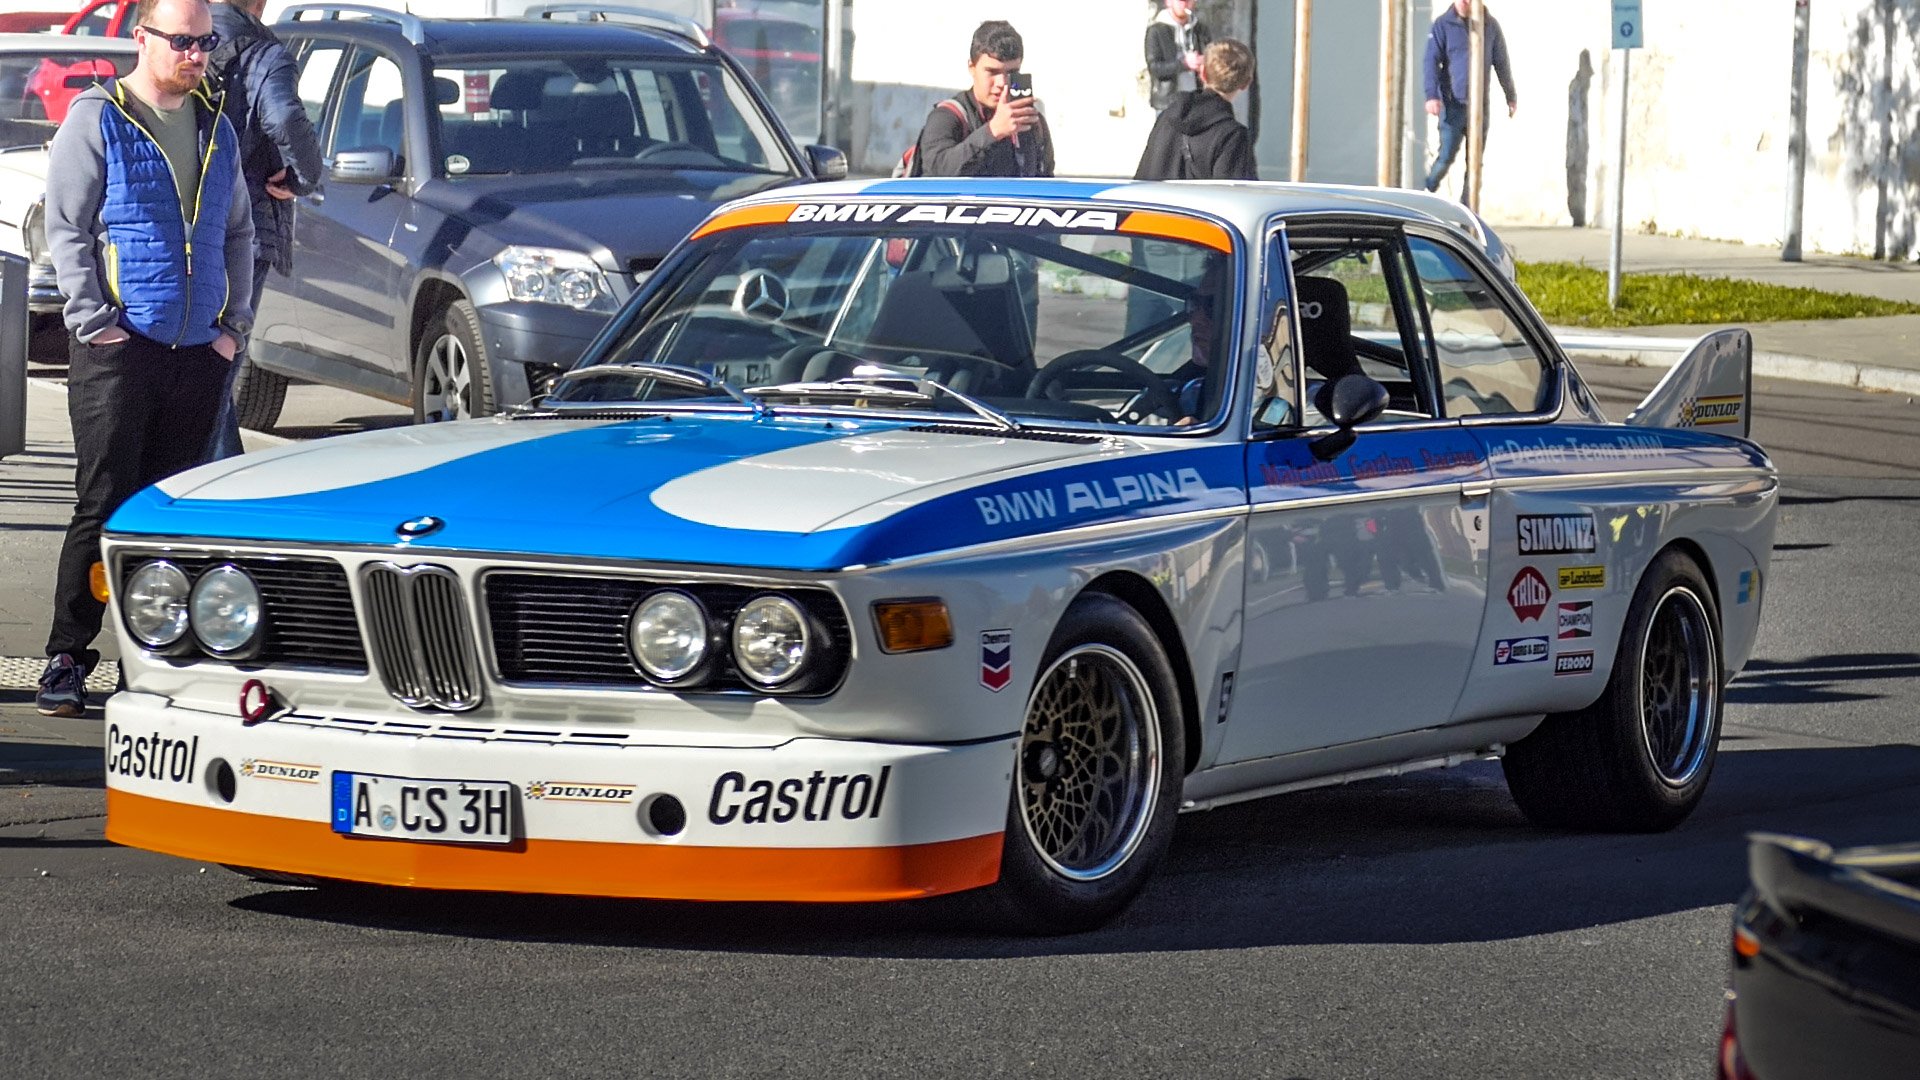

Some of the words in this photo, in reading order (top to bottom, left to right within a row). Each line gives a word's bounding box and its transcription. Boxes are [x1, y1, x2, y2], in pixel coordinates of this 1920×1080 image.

[787, 204, 893, 222] BMW
[896, 204, 1118, 230] ALPINA
[715, 364, 729, 385] M
[1696, 403, 1741, 418] DUNLOP
[1506, 438, 1564, 464] Dealer
[1566, 437, 1615, 463] Team
[1616, 436, 1666, 460] BMW
[975, 488, 1057, 525] BMW
[1065, 467, 1210, 514] ALPINA
[1518, 517, 1594, 551] SIMONIZ
[1512, 573, 1546, 607] TRICO
[1559, 613, 1592, 627] CHAMPION
[1557, 656, 1591, 670] FERODO
[108, 723, 199, 784] Castrol
[256, 764, 320, 780] DUNLOP
[549, 786, 633, 799] DUNLOP
[708, 765, 892, 826] Castrol
[338, 808, 347, 822] D
[354, 781, 373, 828] A
[400, 786, 448, 833] CS
[459, 787, 507, 835] 3H
